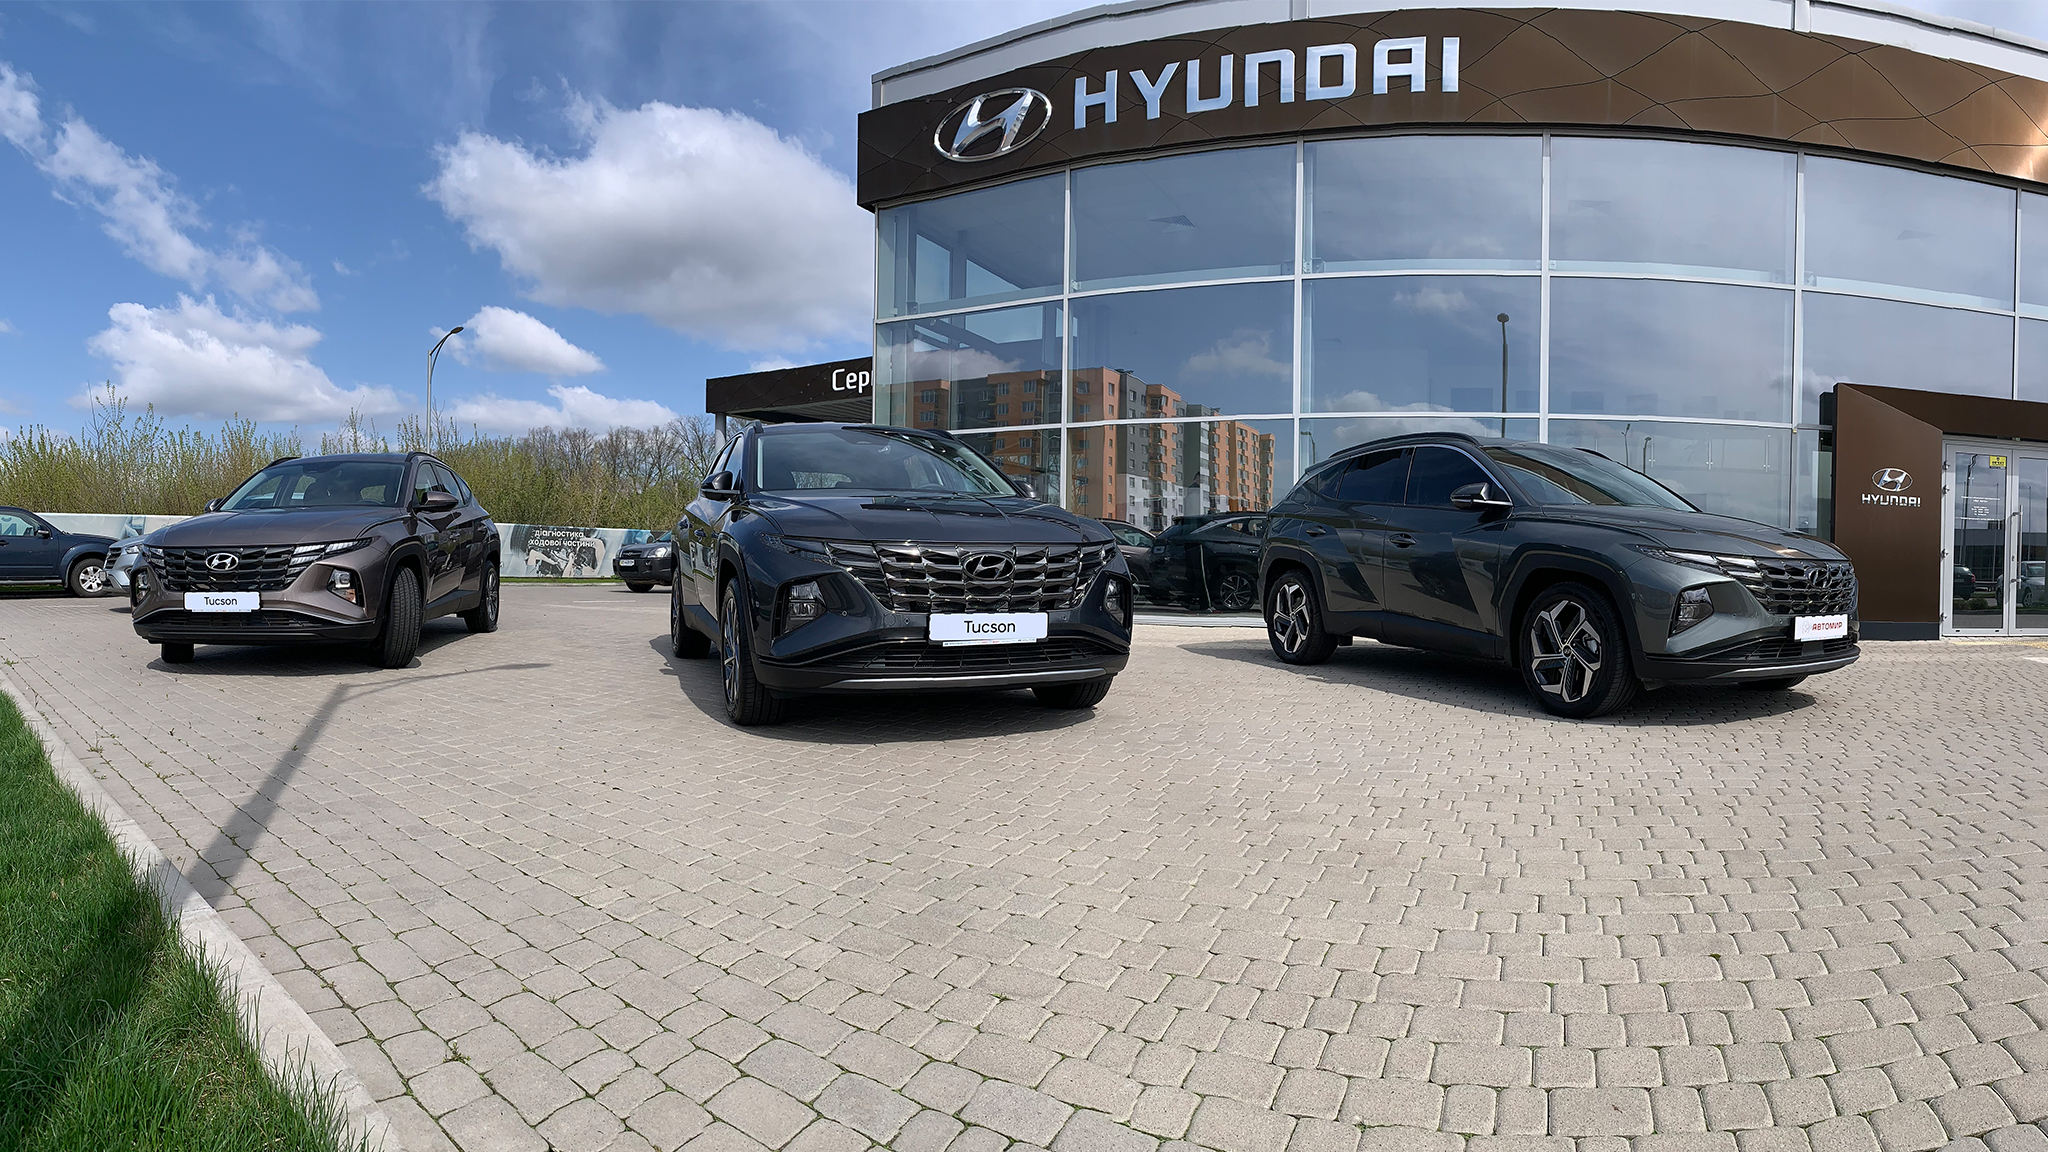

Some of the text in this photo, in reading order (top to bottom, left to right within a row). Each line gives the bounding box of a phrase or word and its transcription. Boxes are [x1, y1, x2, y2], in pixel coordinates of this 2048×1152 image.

[1073, 36, 1461, 129] HYUNDAI
[832, 368, 874, 393] Сер
[1861, 493, 1921, 507] HYUNDAI
[534, 528, 584, 538] діагностика
[204, 596, 238, 606] Tucson
[963, 620, 1016, 634] Tucson
